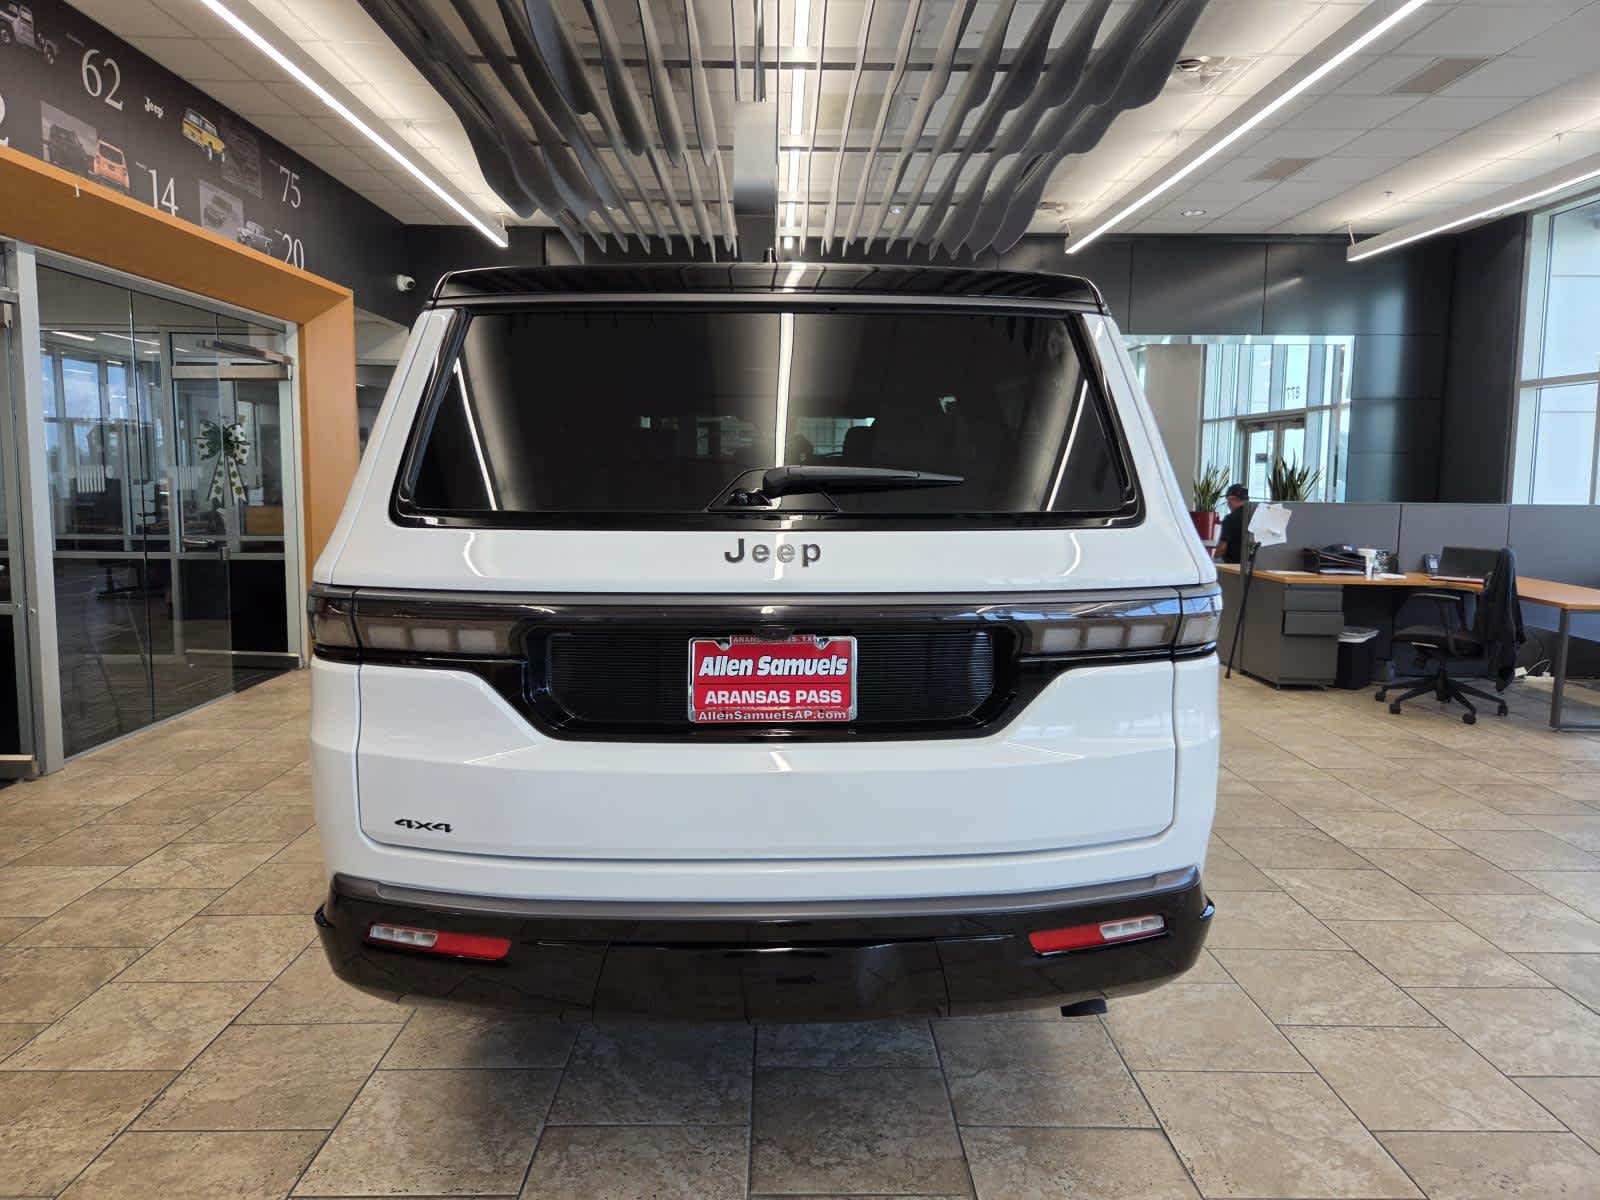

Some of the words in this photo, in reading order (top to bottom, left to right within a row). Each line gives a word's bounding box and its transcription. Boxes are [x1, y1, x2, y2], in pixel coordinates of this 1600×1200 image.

[82, 48, 124, 111] 62
[144, 95, 164, 119] Jeep
[147, 168, 179, 217] 14
[279, 164, 302, 209] 75
[723, 537, 822, 568] Jeep
[698, 655, 754, 677] Allen
[756, 654, 849, 677] Samuels
[704, 690, 791, 705] ARANSAS
[795, 689, 843, 704] PASS
[698, 710, 848, 721] AllenSamuelsAP.com
[393, 818, 454, 833] 4x4
